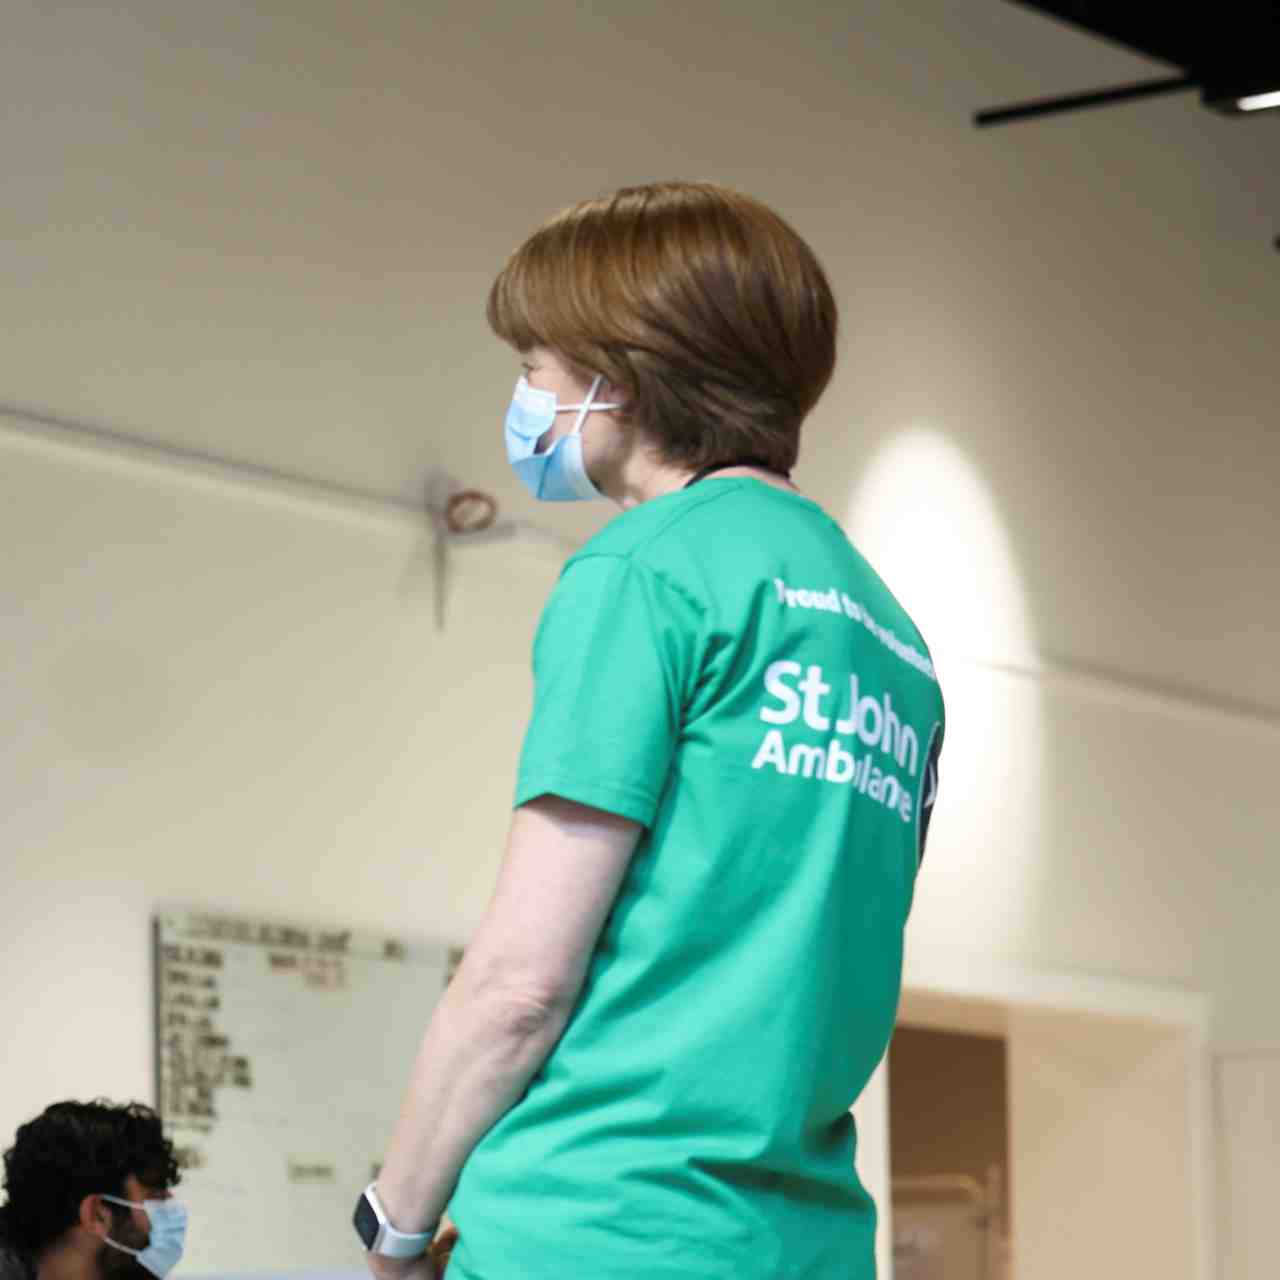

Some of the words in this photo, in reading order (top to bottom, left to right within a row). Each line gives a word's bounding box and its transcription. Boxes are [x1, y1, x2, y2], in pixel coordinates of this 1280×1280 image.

[759, 659, 831, 731] St
[835, 673, 919, 777] John
[750, 729, 914, 822] Amblane
